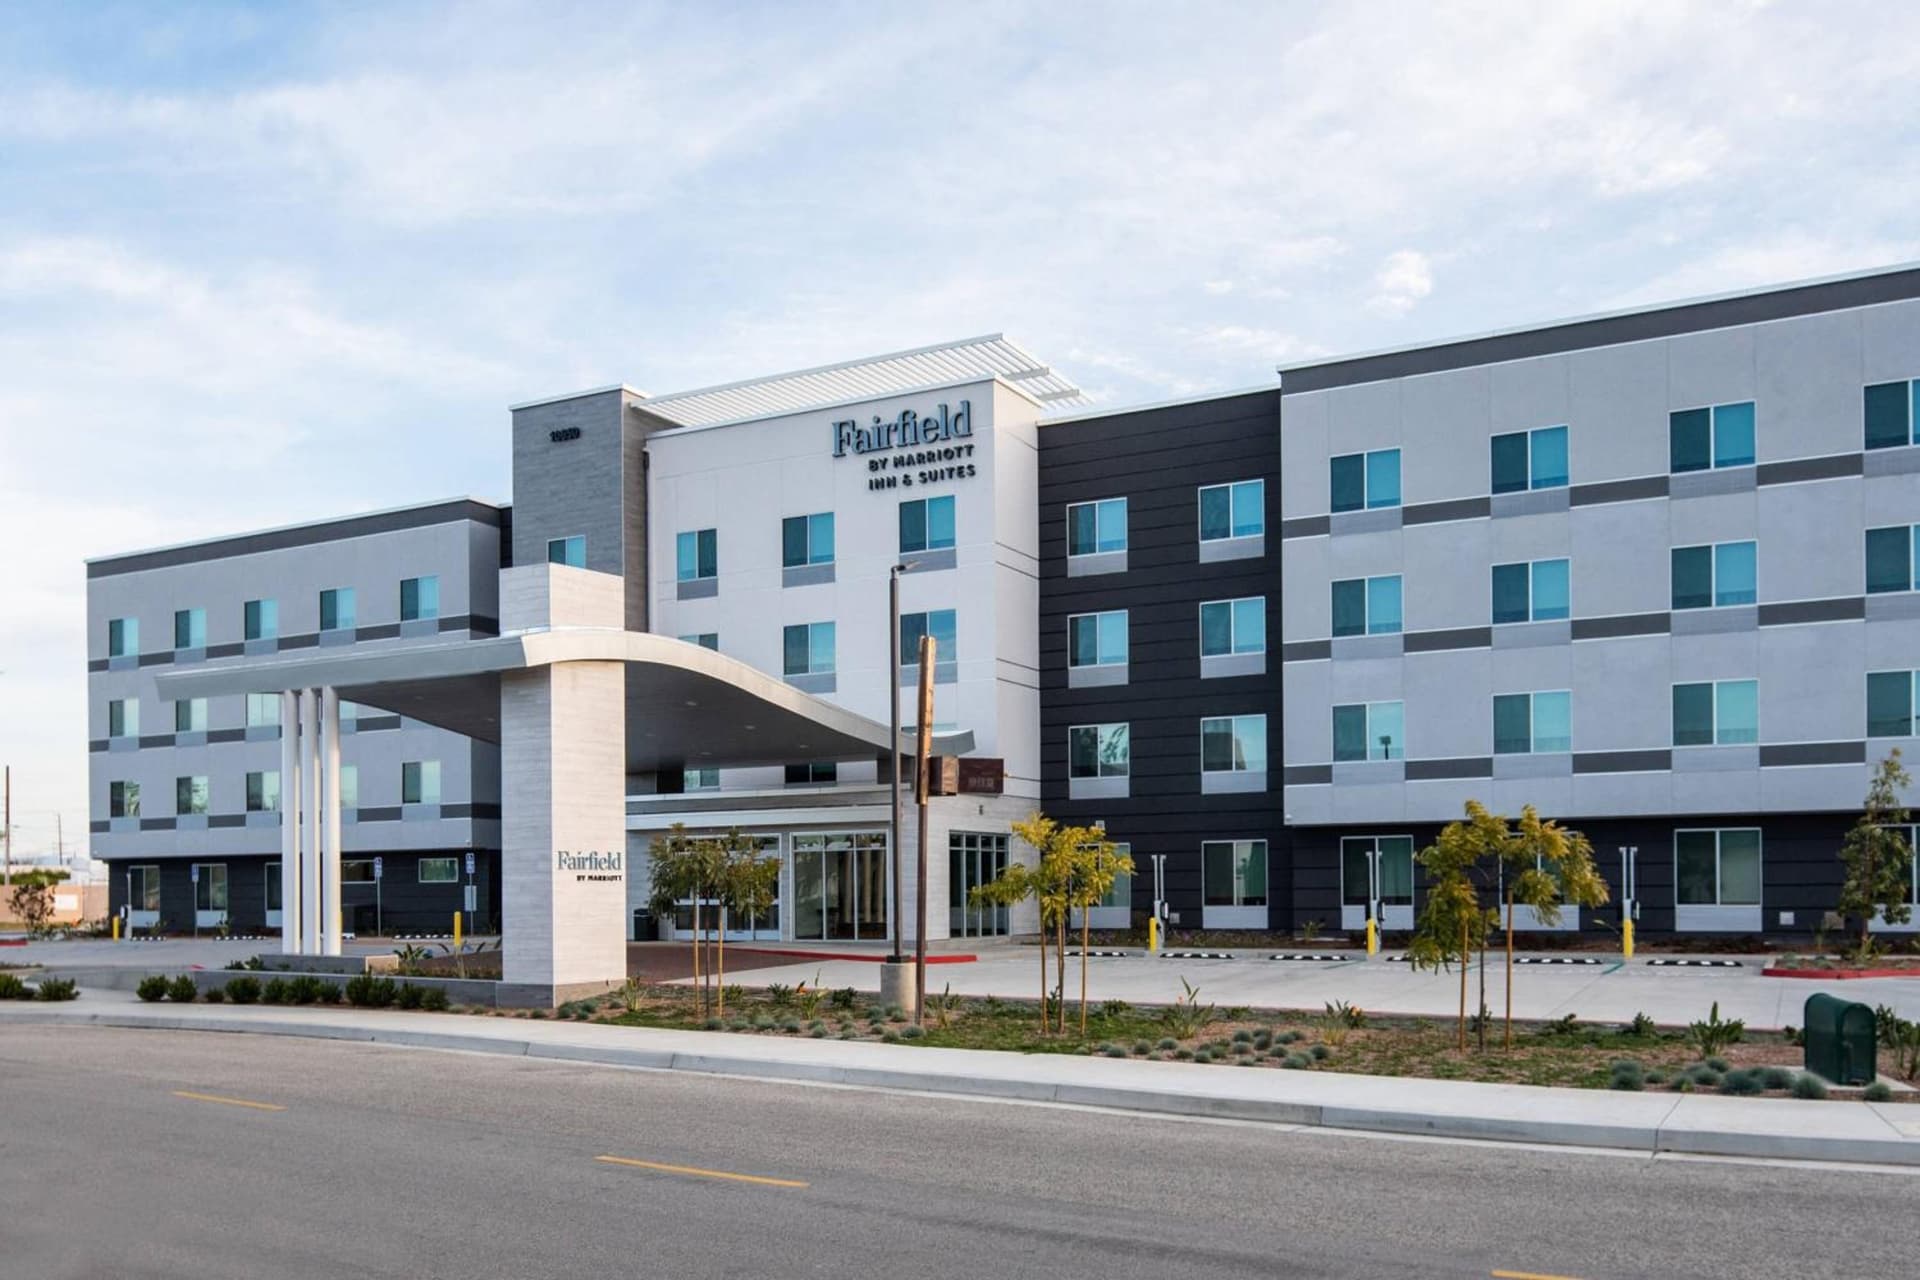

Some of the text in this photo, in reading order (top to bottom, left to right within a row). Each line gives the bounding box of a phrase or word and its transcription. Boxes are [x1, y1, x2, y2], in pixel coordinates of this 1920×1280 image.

[832, 400, 973, 458] Fairfield
[869, 444, 975, 472] BY MARRIOTT
[869, 464, 976, 491] INN & SUITES
[558, 850, 622, 871] Fairfield
